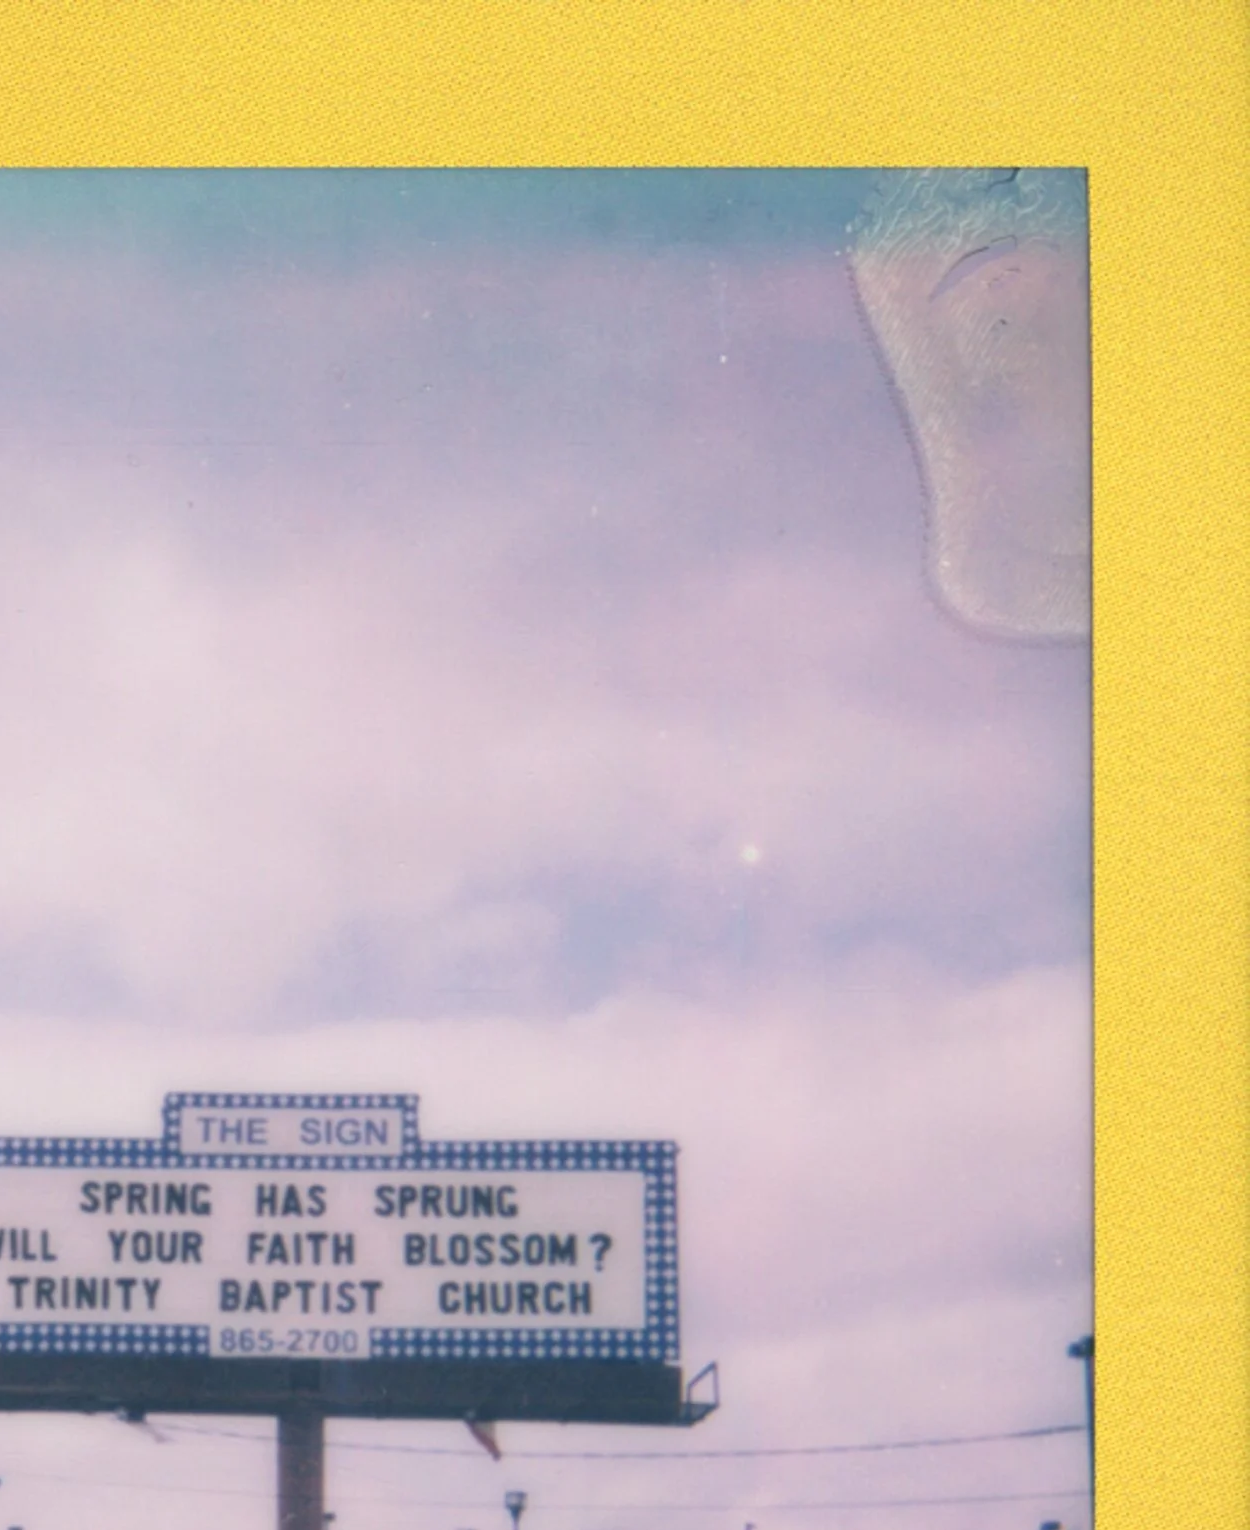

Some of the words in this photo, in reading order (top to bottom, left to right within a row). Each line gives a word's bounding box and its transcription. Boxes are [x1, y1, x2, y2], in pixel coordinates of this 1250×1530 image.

[197, 1117, 268, 1144] THE
[300, 1117, 388, 1145] SIGN
[79, 1181, 212, 1216] SPRING
[256, 1184, 327, 1217] HAS
[374, 1184, 518, 1218] SPRUNG
[107, 1230, 204, 1263] YOUR
[247, 1232, 355, 1265] FAITH
[7, 1276, 161, 1311] TRINITY
[219, 1279, 383, 1315] BAPTIST
[438, 1281, 592, 1315] CHURCH
[220, 1328, 359, 1354] 865-2700
